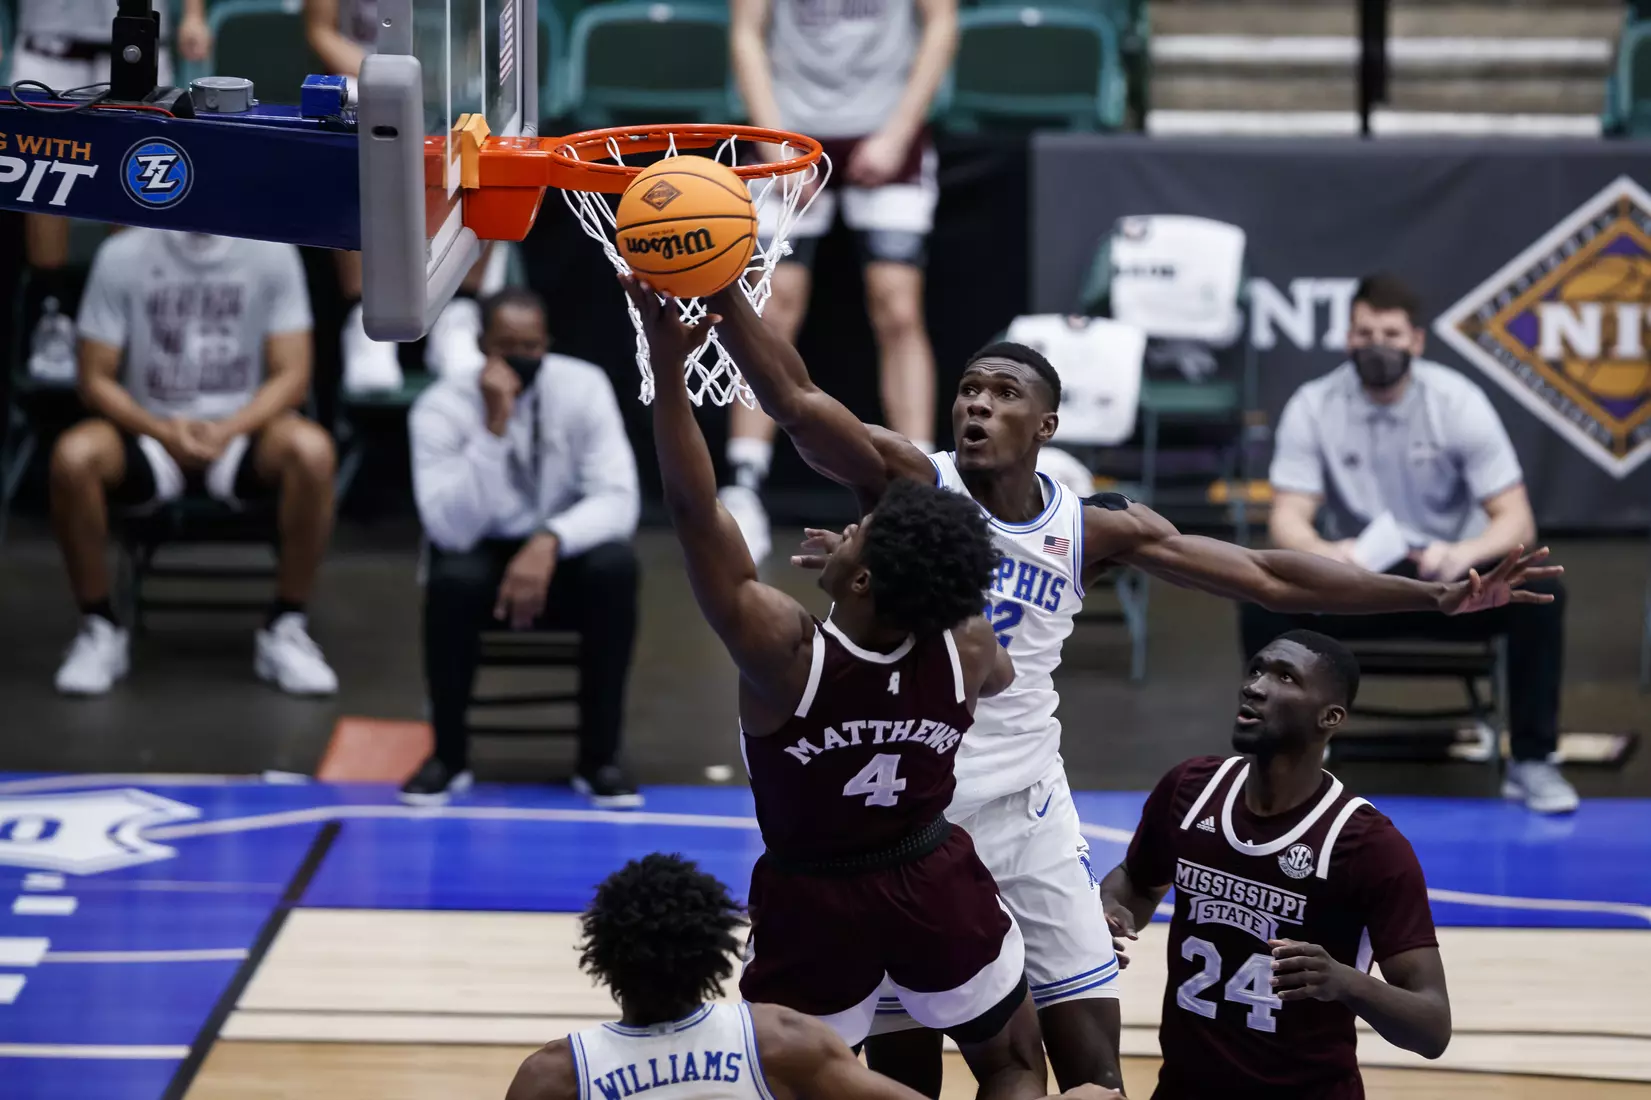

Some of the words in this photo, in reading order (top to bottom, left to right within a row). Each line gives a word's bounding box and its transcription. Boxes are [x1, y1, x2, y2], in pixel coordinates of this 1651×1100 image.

[15, 134, 92, 161] WITH
[624, 228, 716, 260] Wilson
[1536, 303, 1651, 361] NI
[989, 556, 1066, 613] PHIS
[984, 601, 1024, 649] 2
[784, 719, 961, 765] MATTHEWS
[842, 753, 907, 807] 4
[1287, 845, 1310, 870] SEC
[1175, 862, 1307, 921] MISSISSIPPI
[1203, 904, 1263, 936] STATE
[1176, 935, 1283, 1033] 24
[594, 1051, 742, 1100] WILLIAMS
